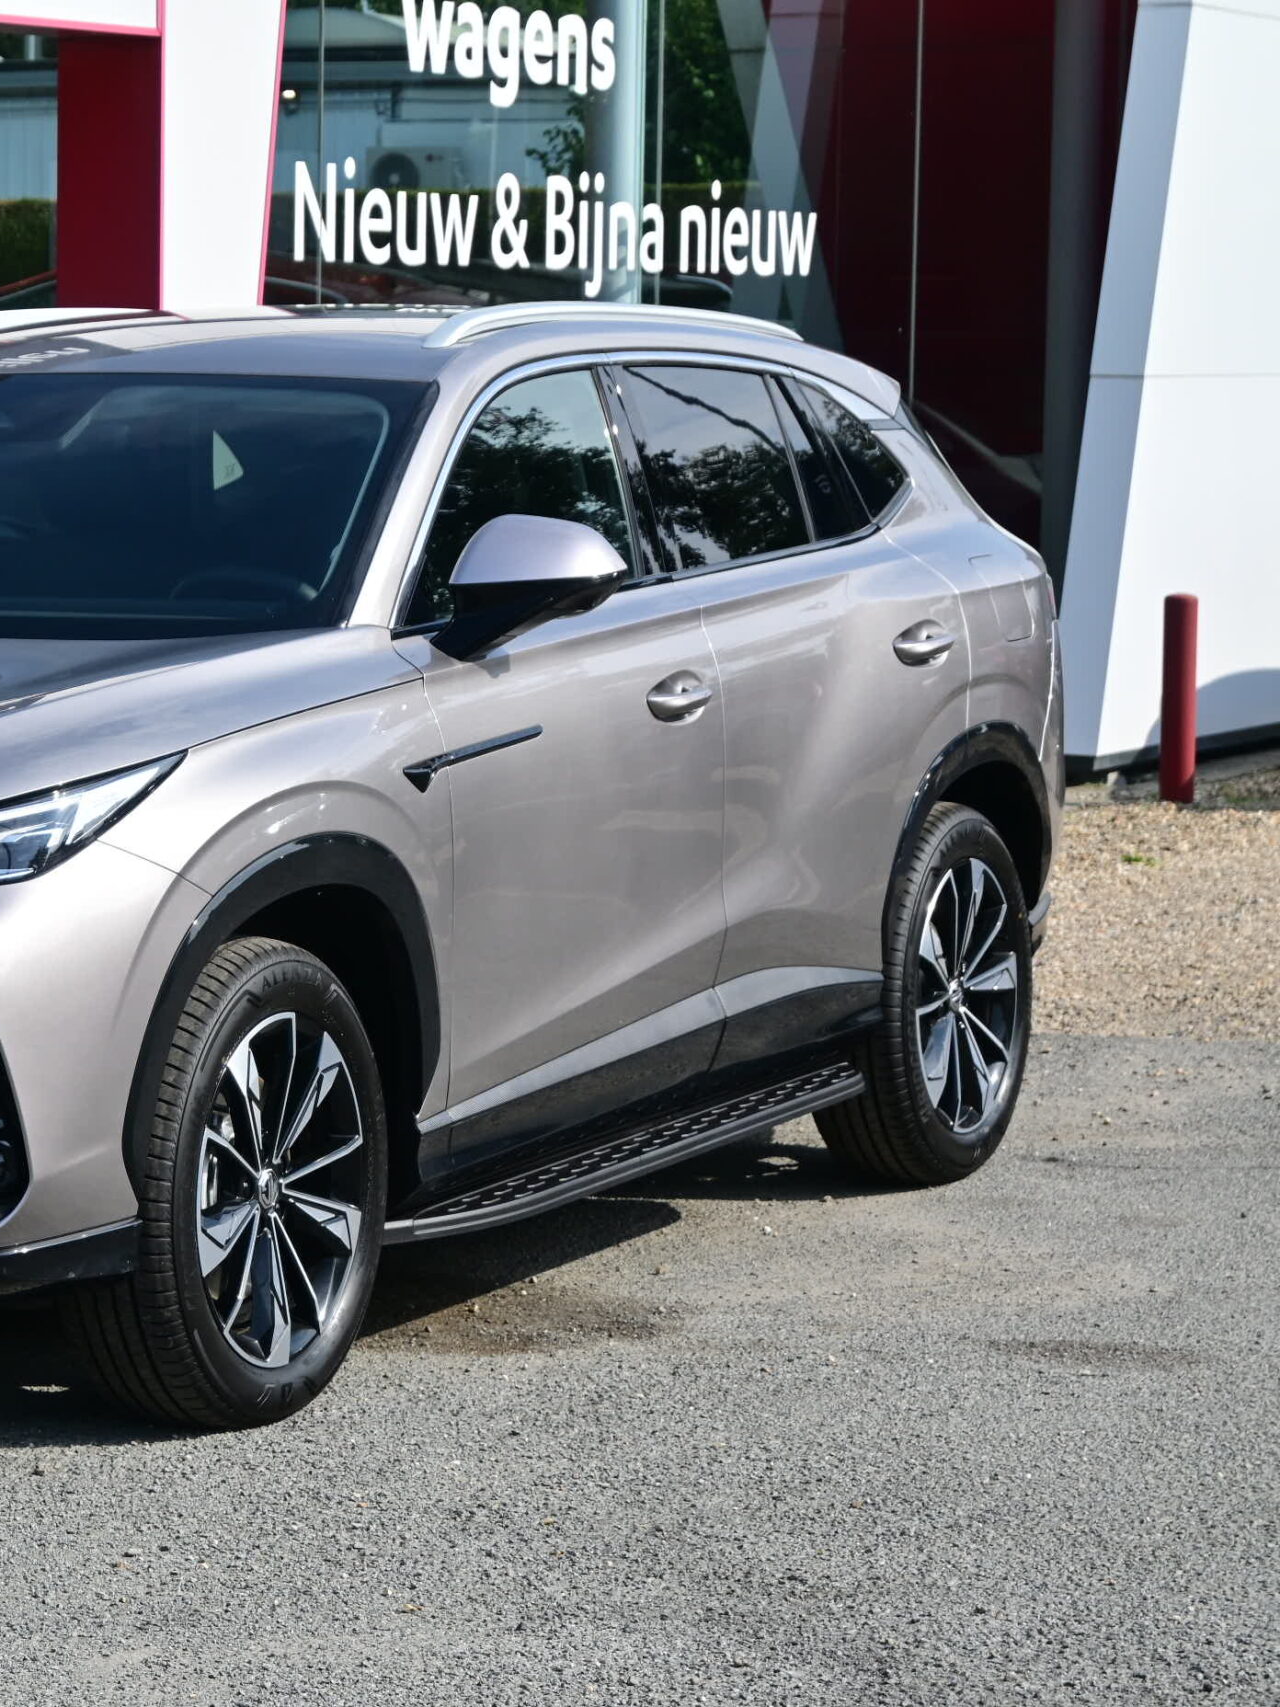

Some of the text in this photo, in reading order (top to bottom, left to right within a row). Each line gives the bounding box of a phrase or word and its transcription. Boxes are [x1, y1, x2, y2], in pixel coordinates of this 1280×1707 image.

[402, 0, 617, 108] Wagens
[293, 156, 818, 298] Nieuw & Bijna nieuw
